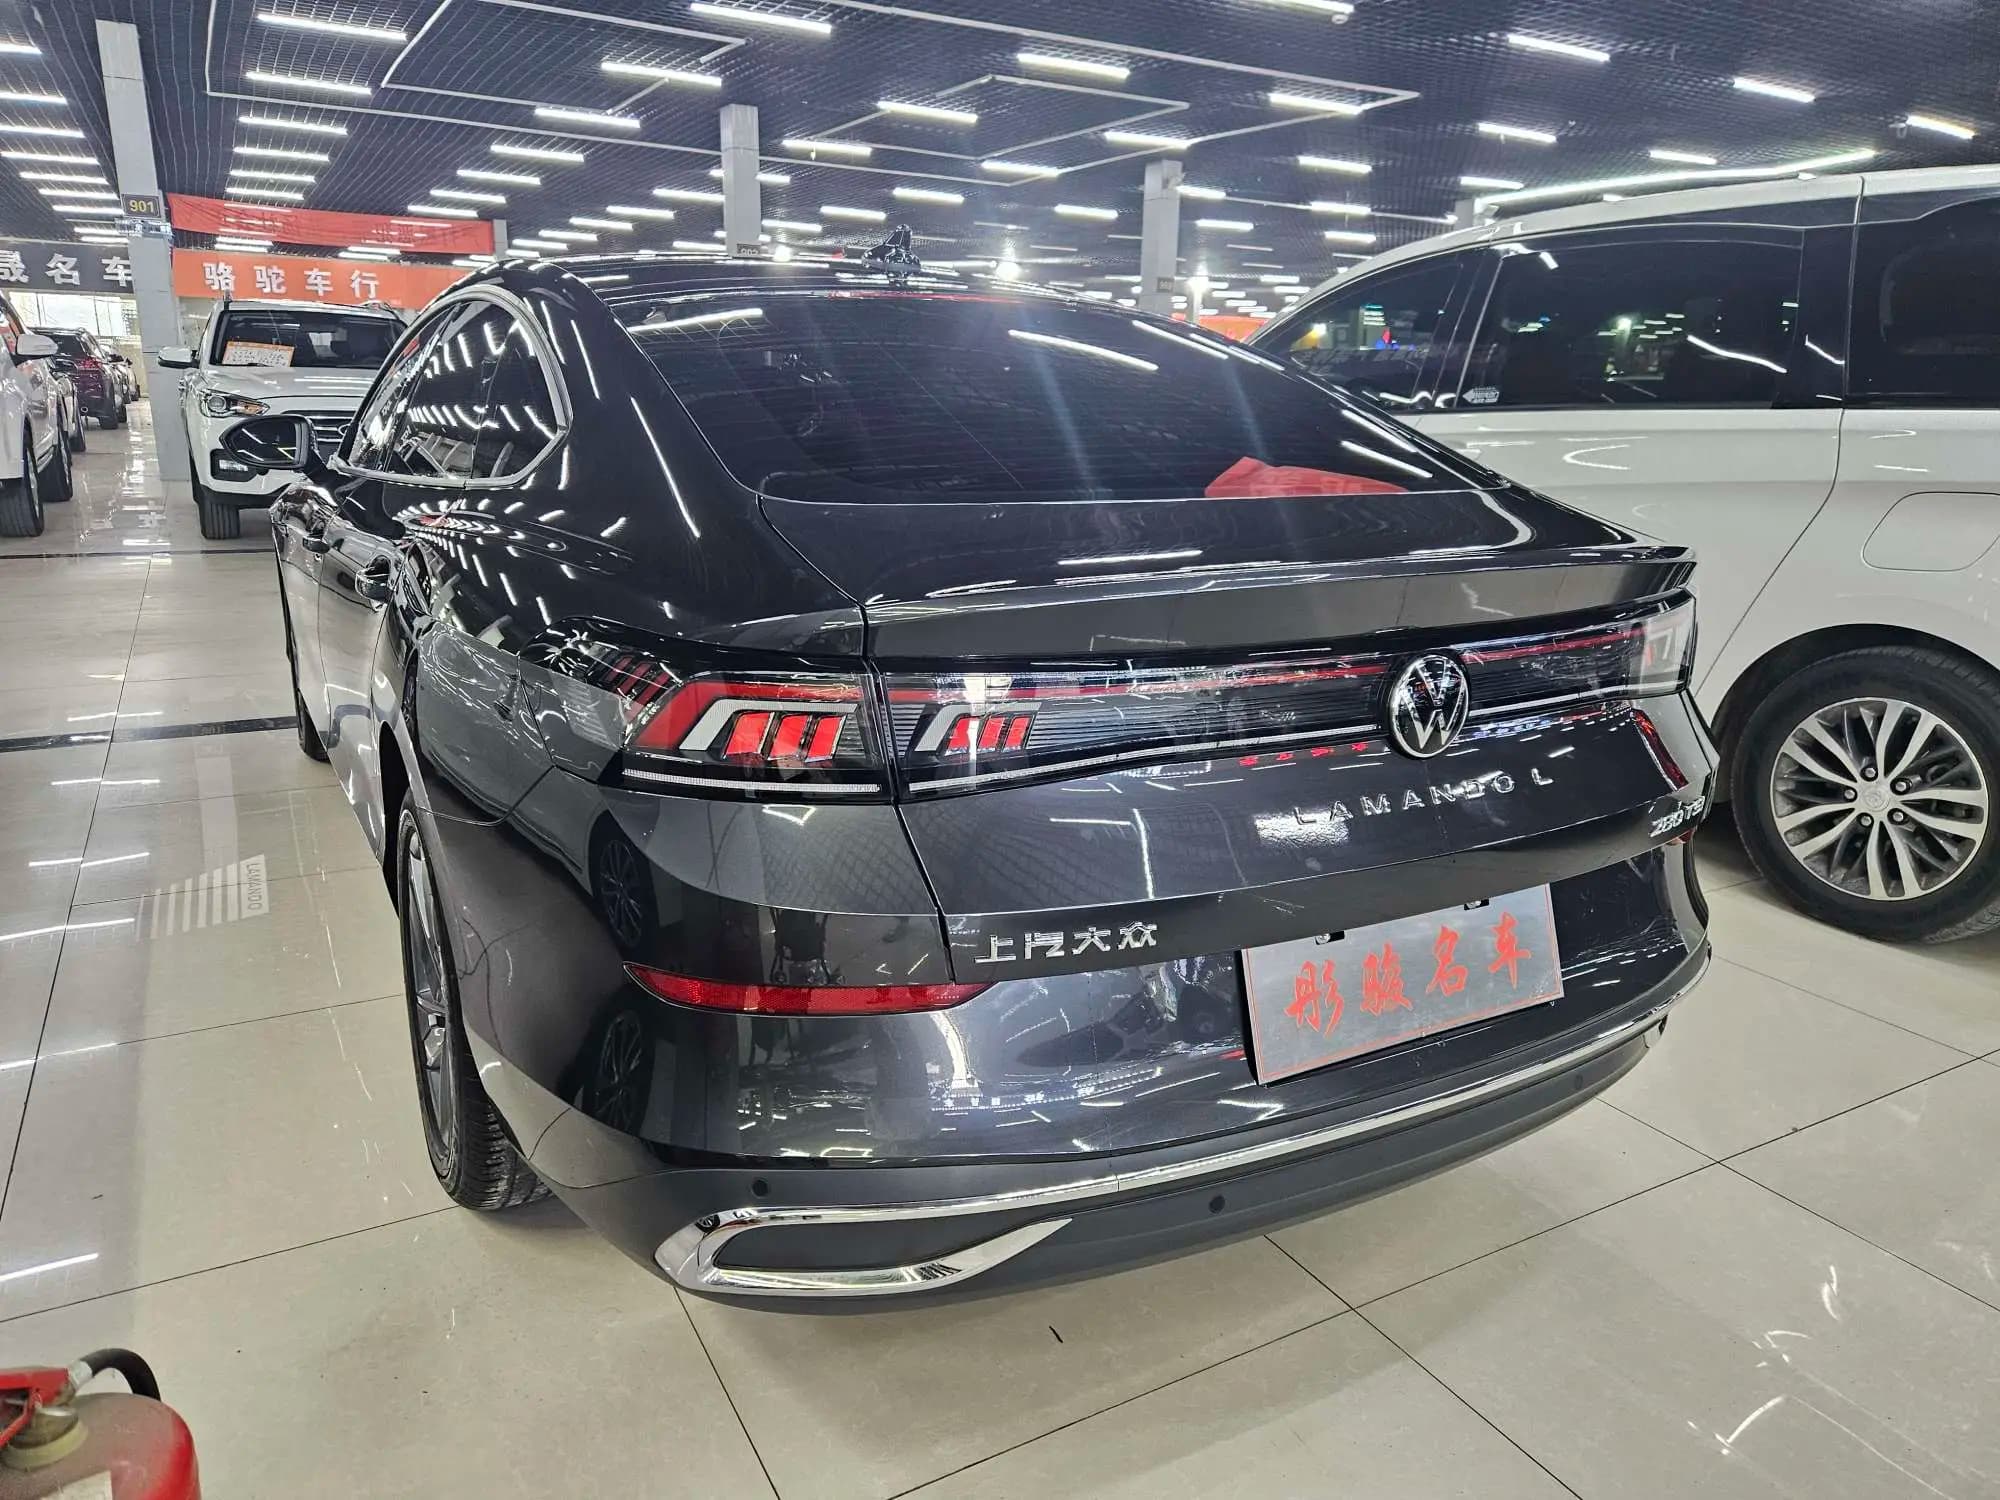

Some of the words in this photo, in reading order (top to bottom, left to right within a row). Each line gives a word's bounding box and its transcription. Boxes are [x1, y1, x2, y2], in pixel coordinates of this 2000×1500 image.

[129, 199, 154, 213] 901
[203, 262, 379, 298] 骆驼车行
[1293, 773, 1515, 826] LAMANDO
[1531, 768, 1553, 786] L
[246, 863, 263, 911] LAMANDO
[974, 921, 1158, 963] 上汽大众
